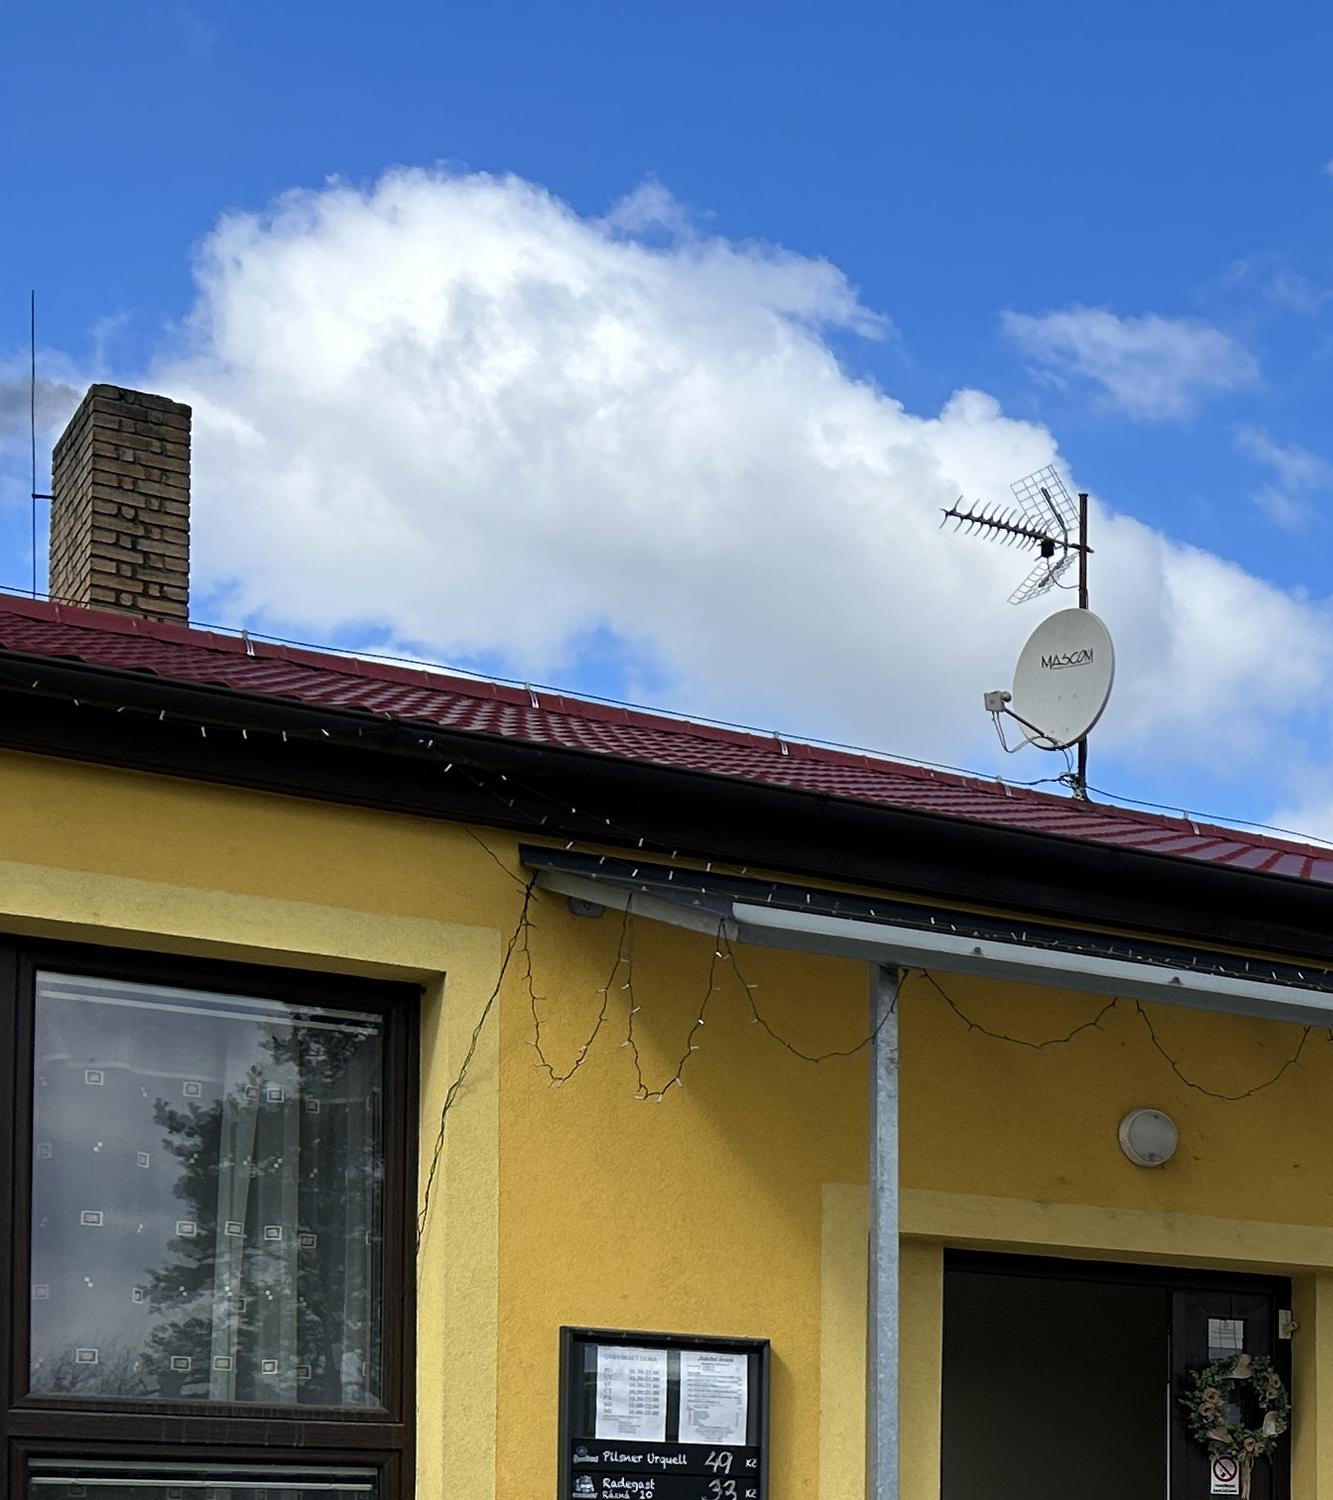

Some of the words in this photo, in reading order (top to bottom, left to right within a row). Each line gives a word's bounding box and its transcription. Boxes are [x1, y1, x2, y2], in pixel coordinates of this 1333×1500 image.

[603, 1451, 643, 1463] Pilsner
[647, 1453, 688, 1469] Urquell
[704, 1451, 734, 1474] 49
[602, 1477, 655, 1492] Radegast
